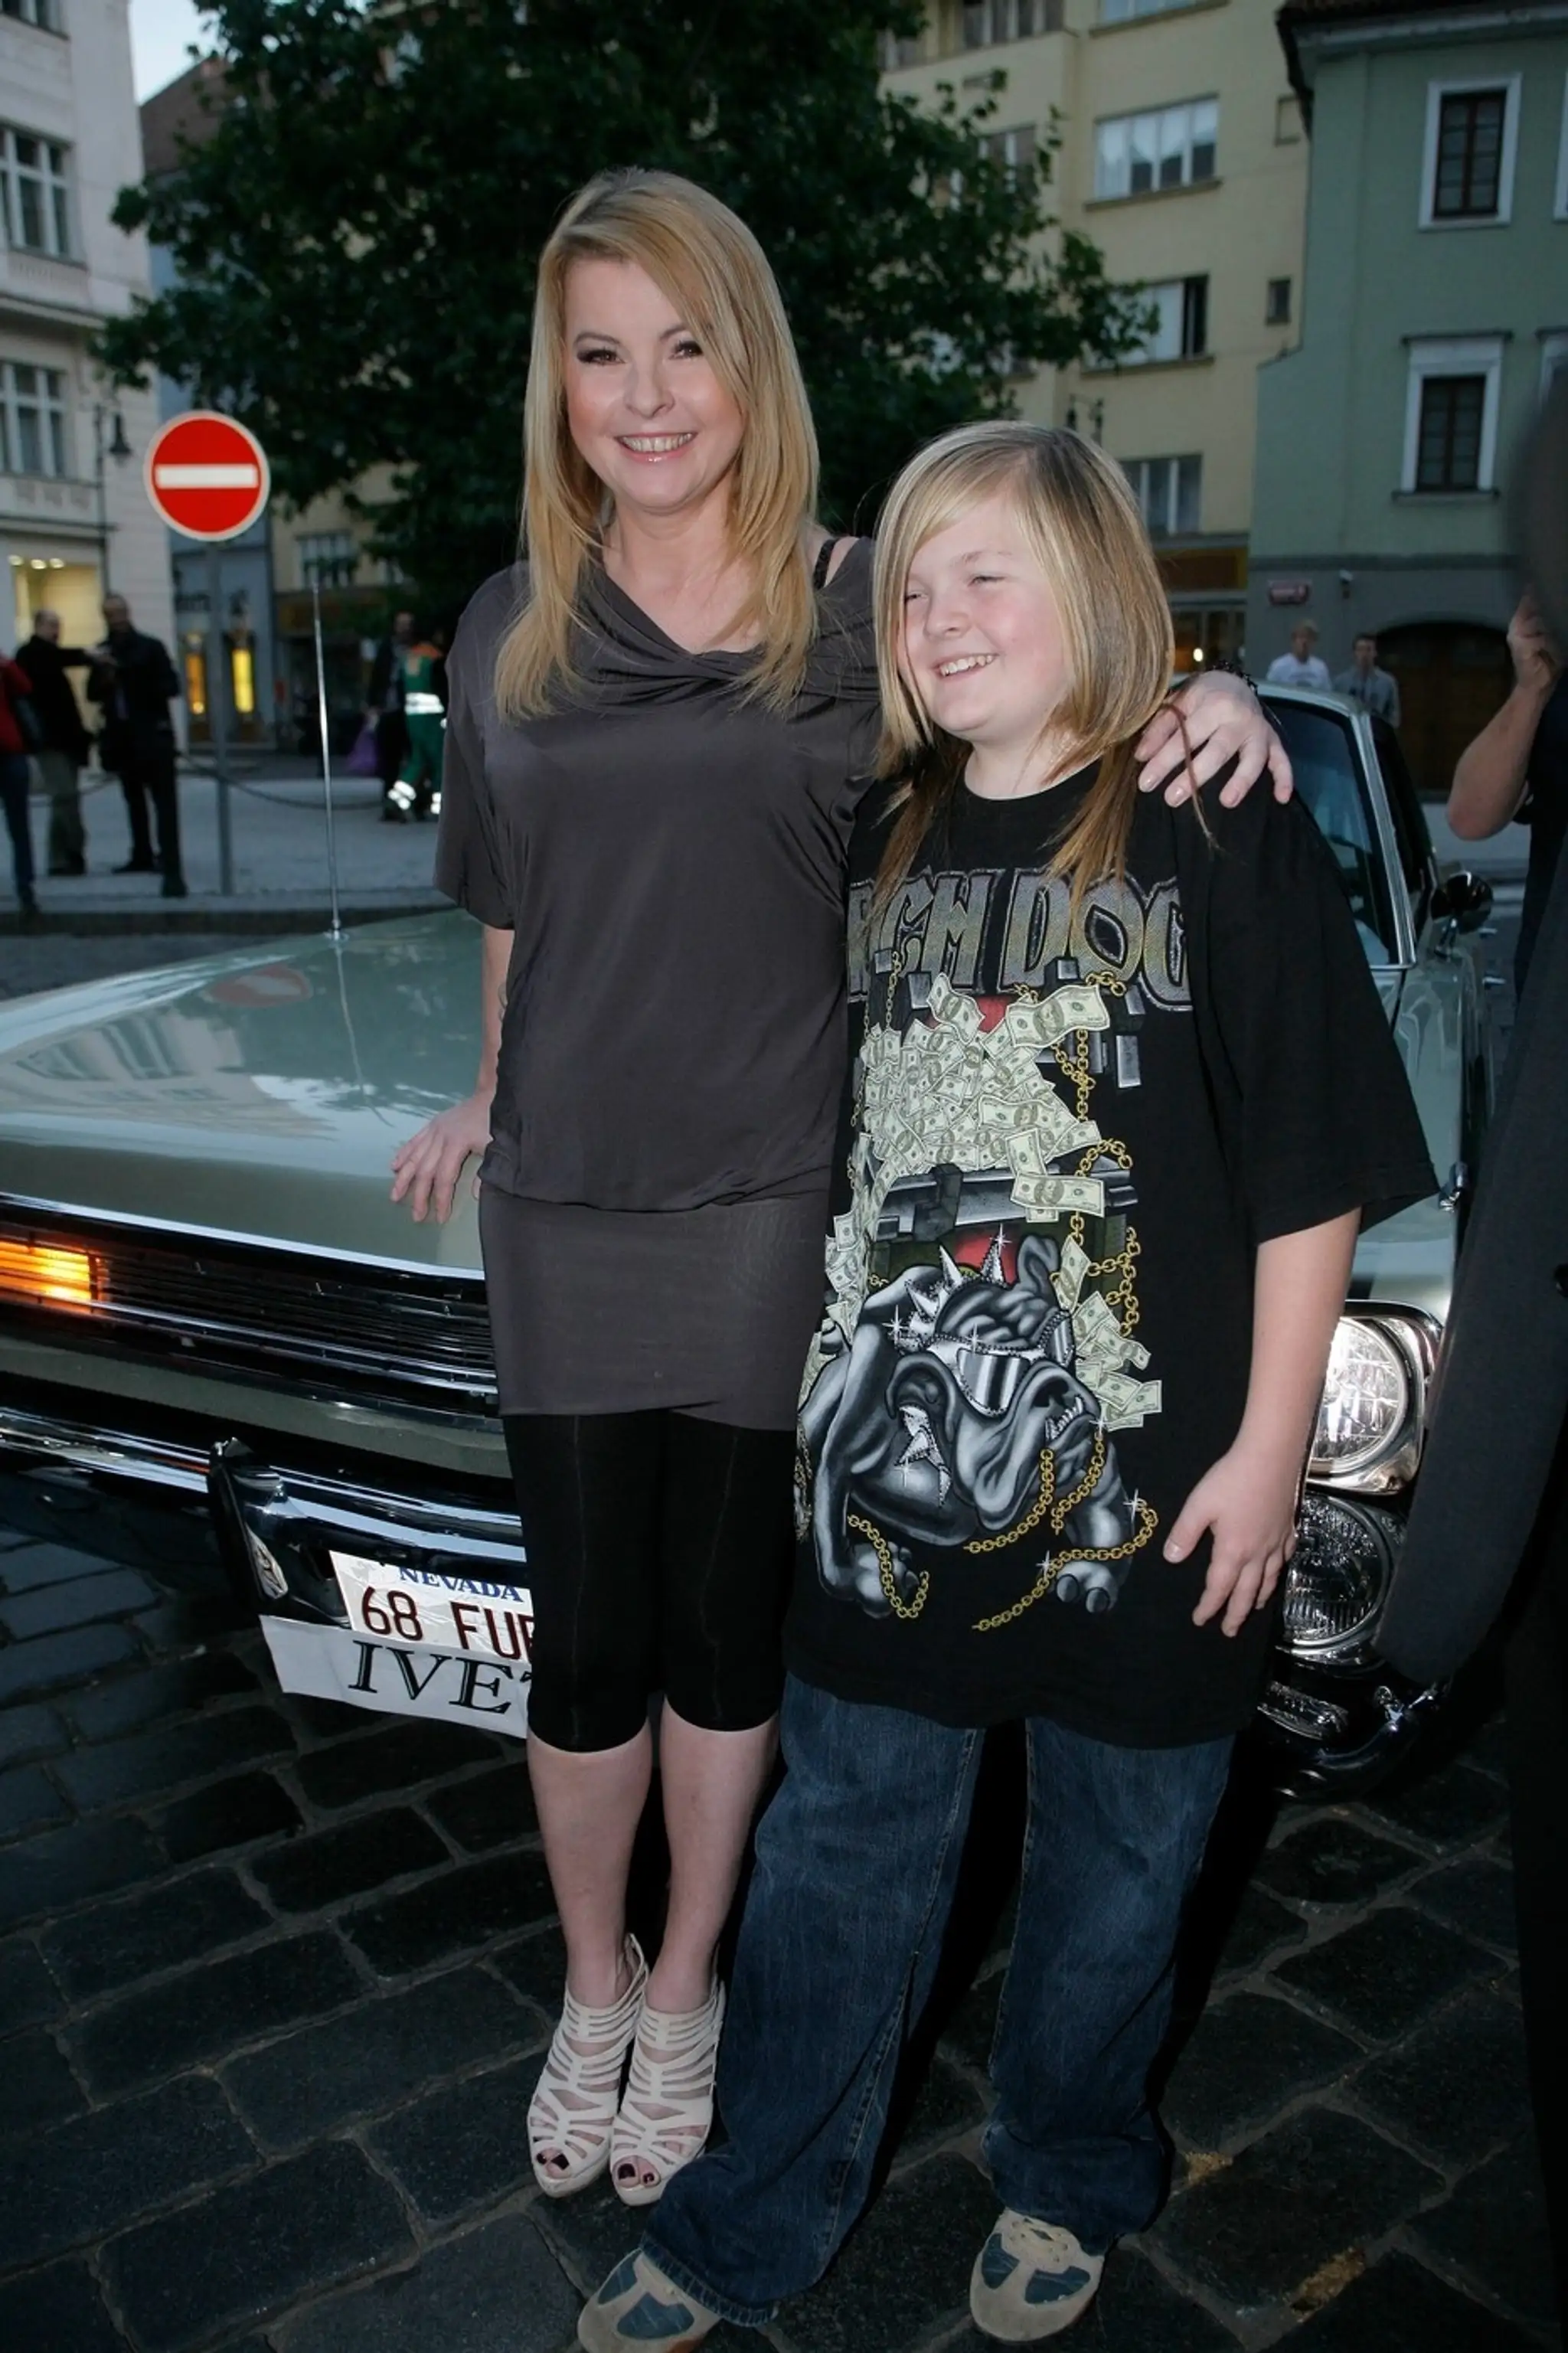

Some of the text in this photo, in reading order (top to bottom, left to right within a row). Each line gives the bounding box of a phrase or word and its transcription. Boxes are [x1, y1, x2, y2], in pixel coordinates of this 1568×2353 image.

[397, 1567, 524, 1603] NEVADA
[361, 1587, 423, 1642] 68
[348, 1640, 532, 1714] IVE
